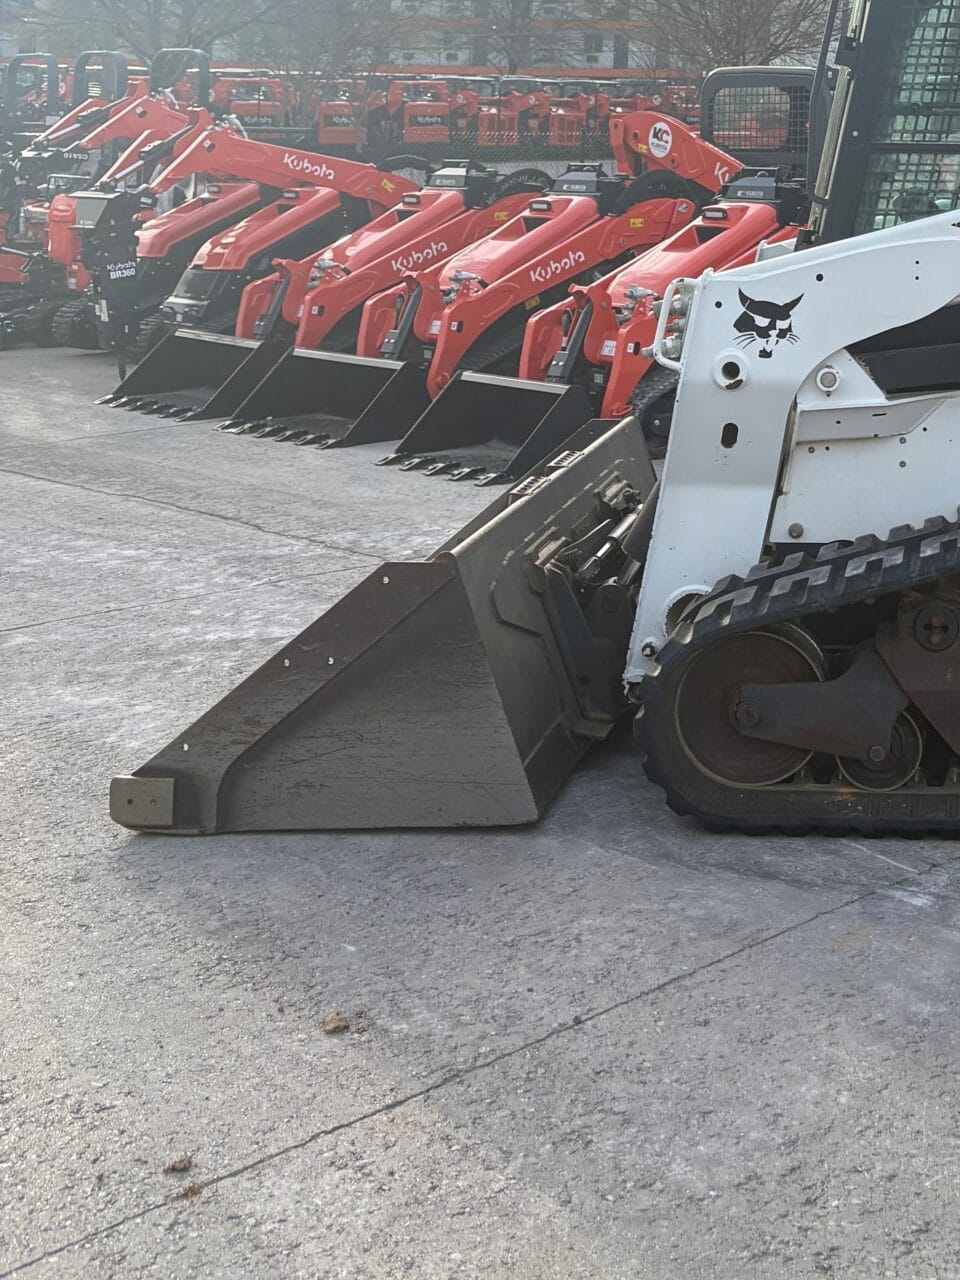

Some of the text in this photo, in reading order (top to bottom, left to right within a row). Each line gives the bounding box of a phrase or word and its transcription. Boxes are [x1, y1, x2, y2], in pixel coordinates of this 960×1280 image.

[652, 126, 670, 144] KC
[284, 152, 335, 181] Kubota
[391, 240, 449, 272] Kubota
[529, 250, 586, 283] Kubota
[110, 268, 136, 280] BR360
